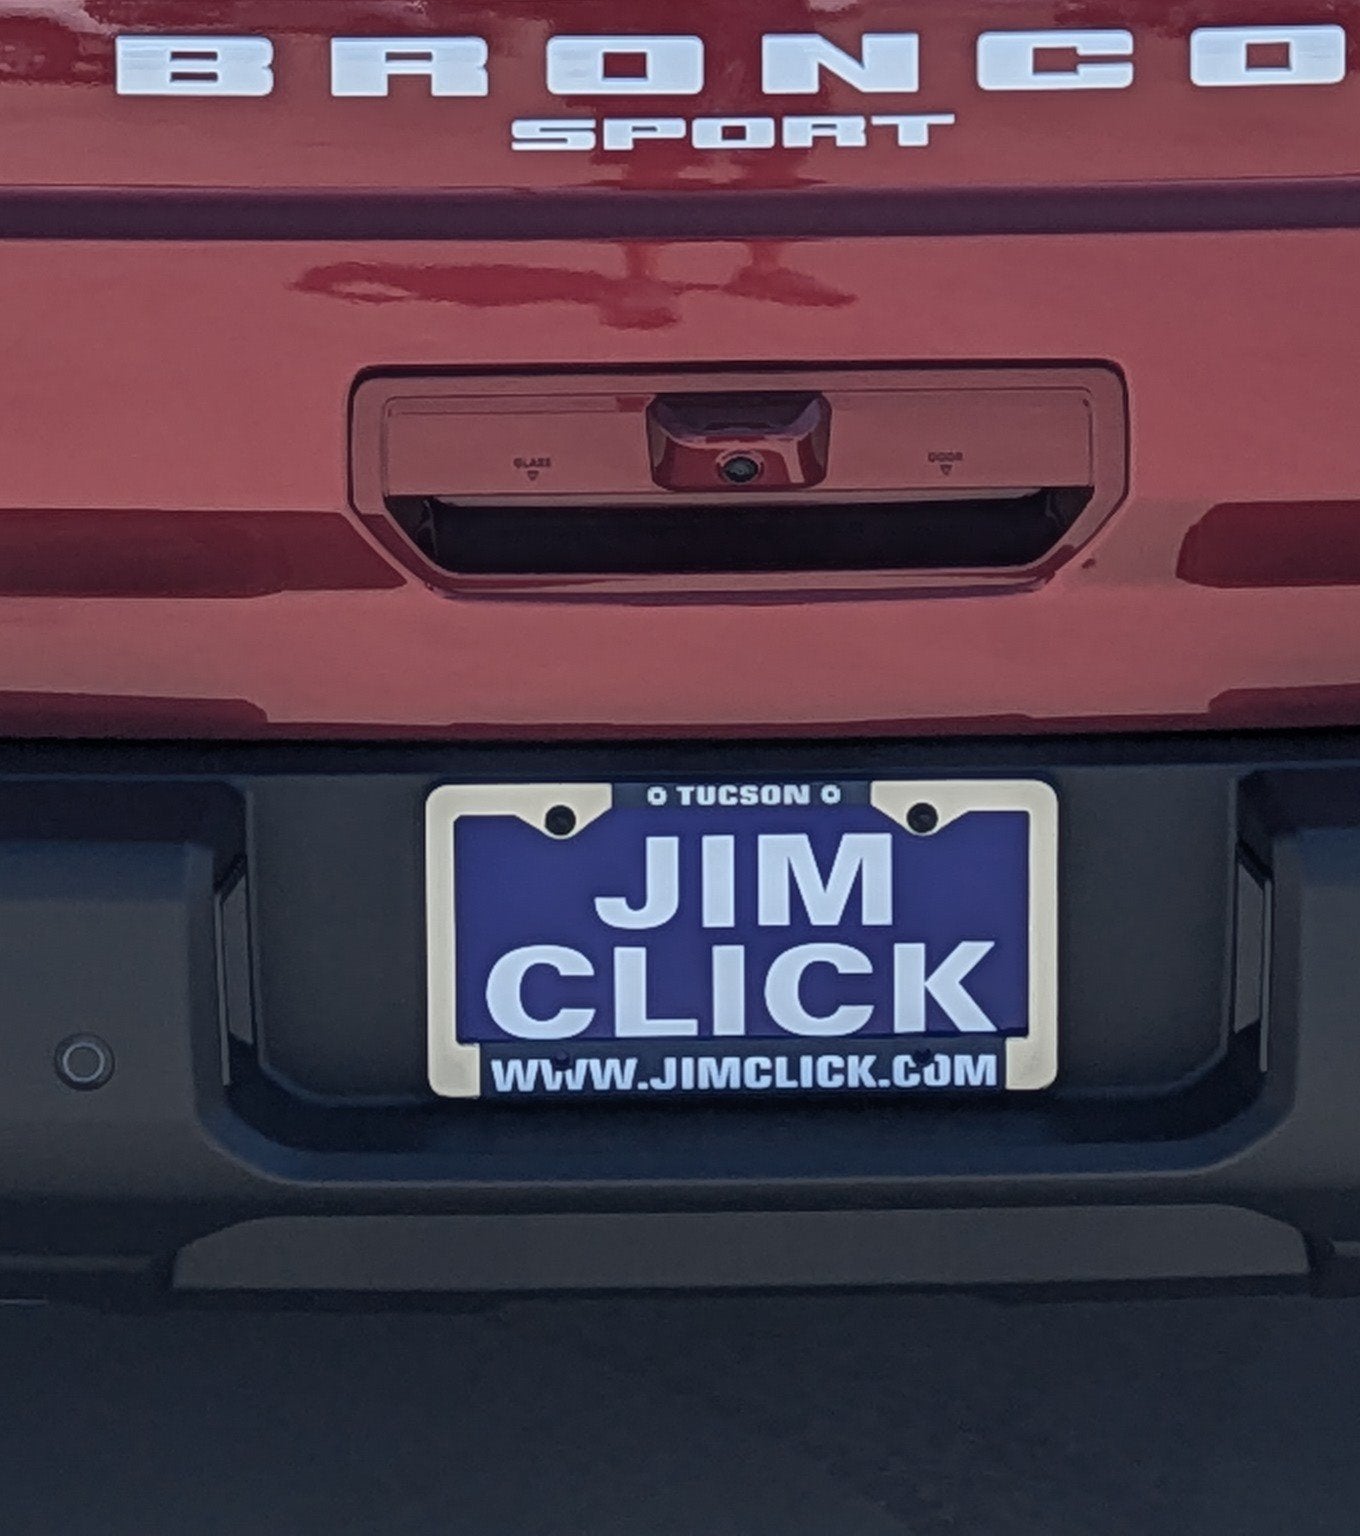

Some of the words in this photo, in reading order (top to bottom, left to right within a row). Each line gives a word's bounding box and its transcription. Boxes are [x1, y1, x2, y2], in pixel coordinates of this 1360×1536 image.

[115, 26, 1346, 97] BRONCO
[511, 114, 955, 152] SPORT
[676, 785, 811, 806] TUCSON
[594, 833, 893, 929] JIM
[485, 940, 998, 1040] CLICK
[491, 1054, 998, 1092] WWW.JIMCLICK.COM
